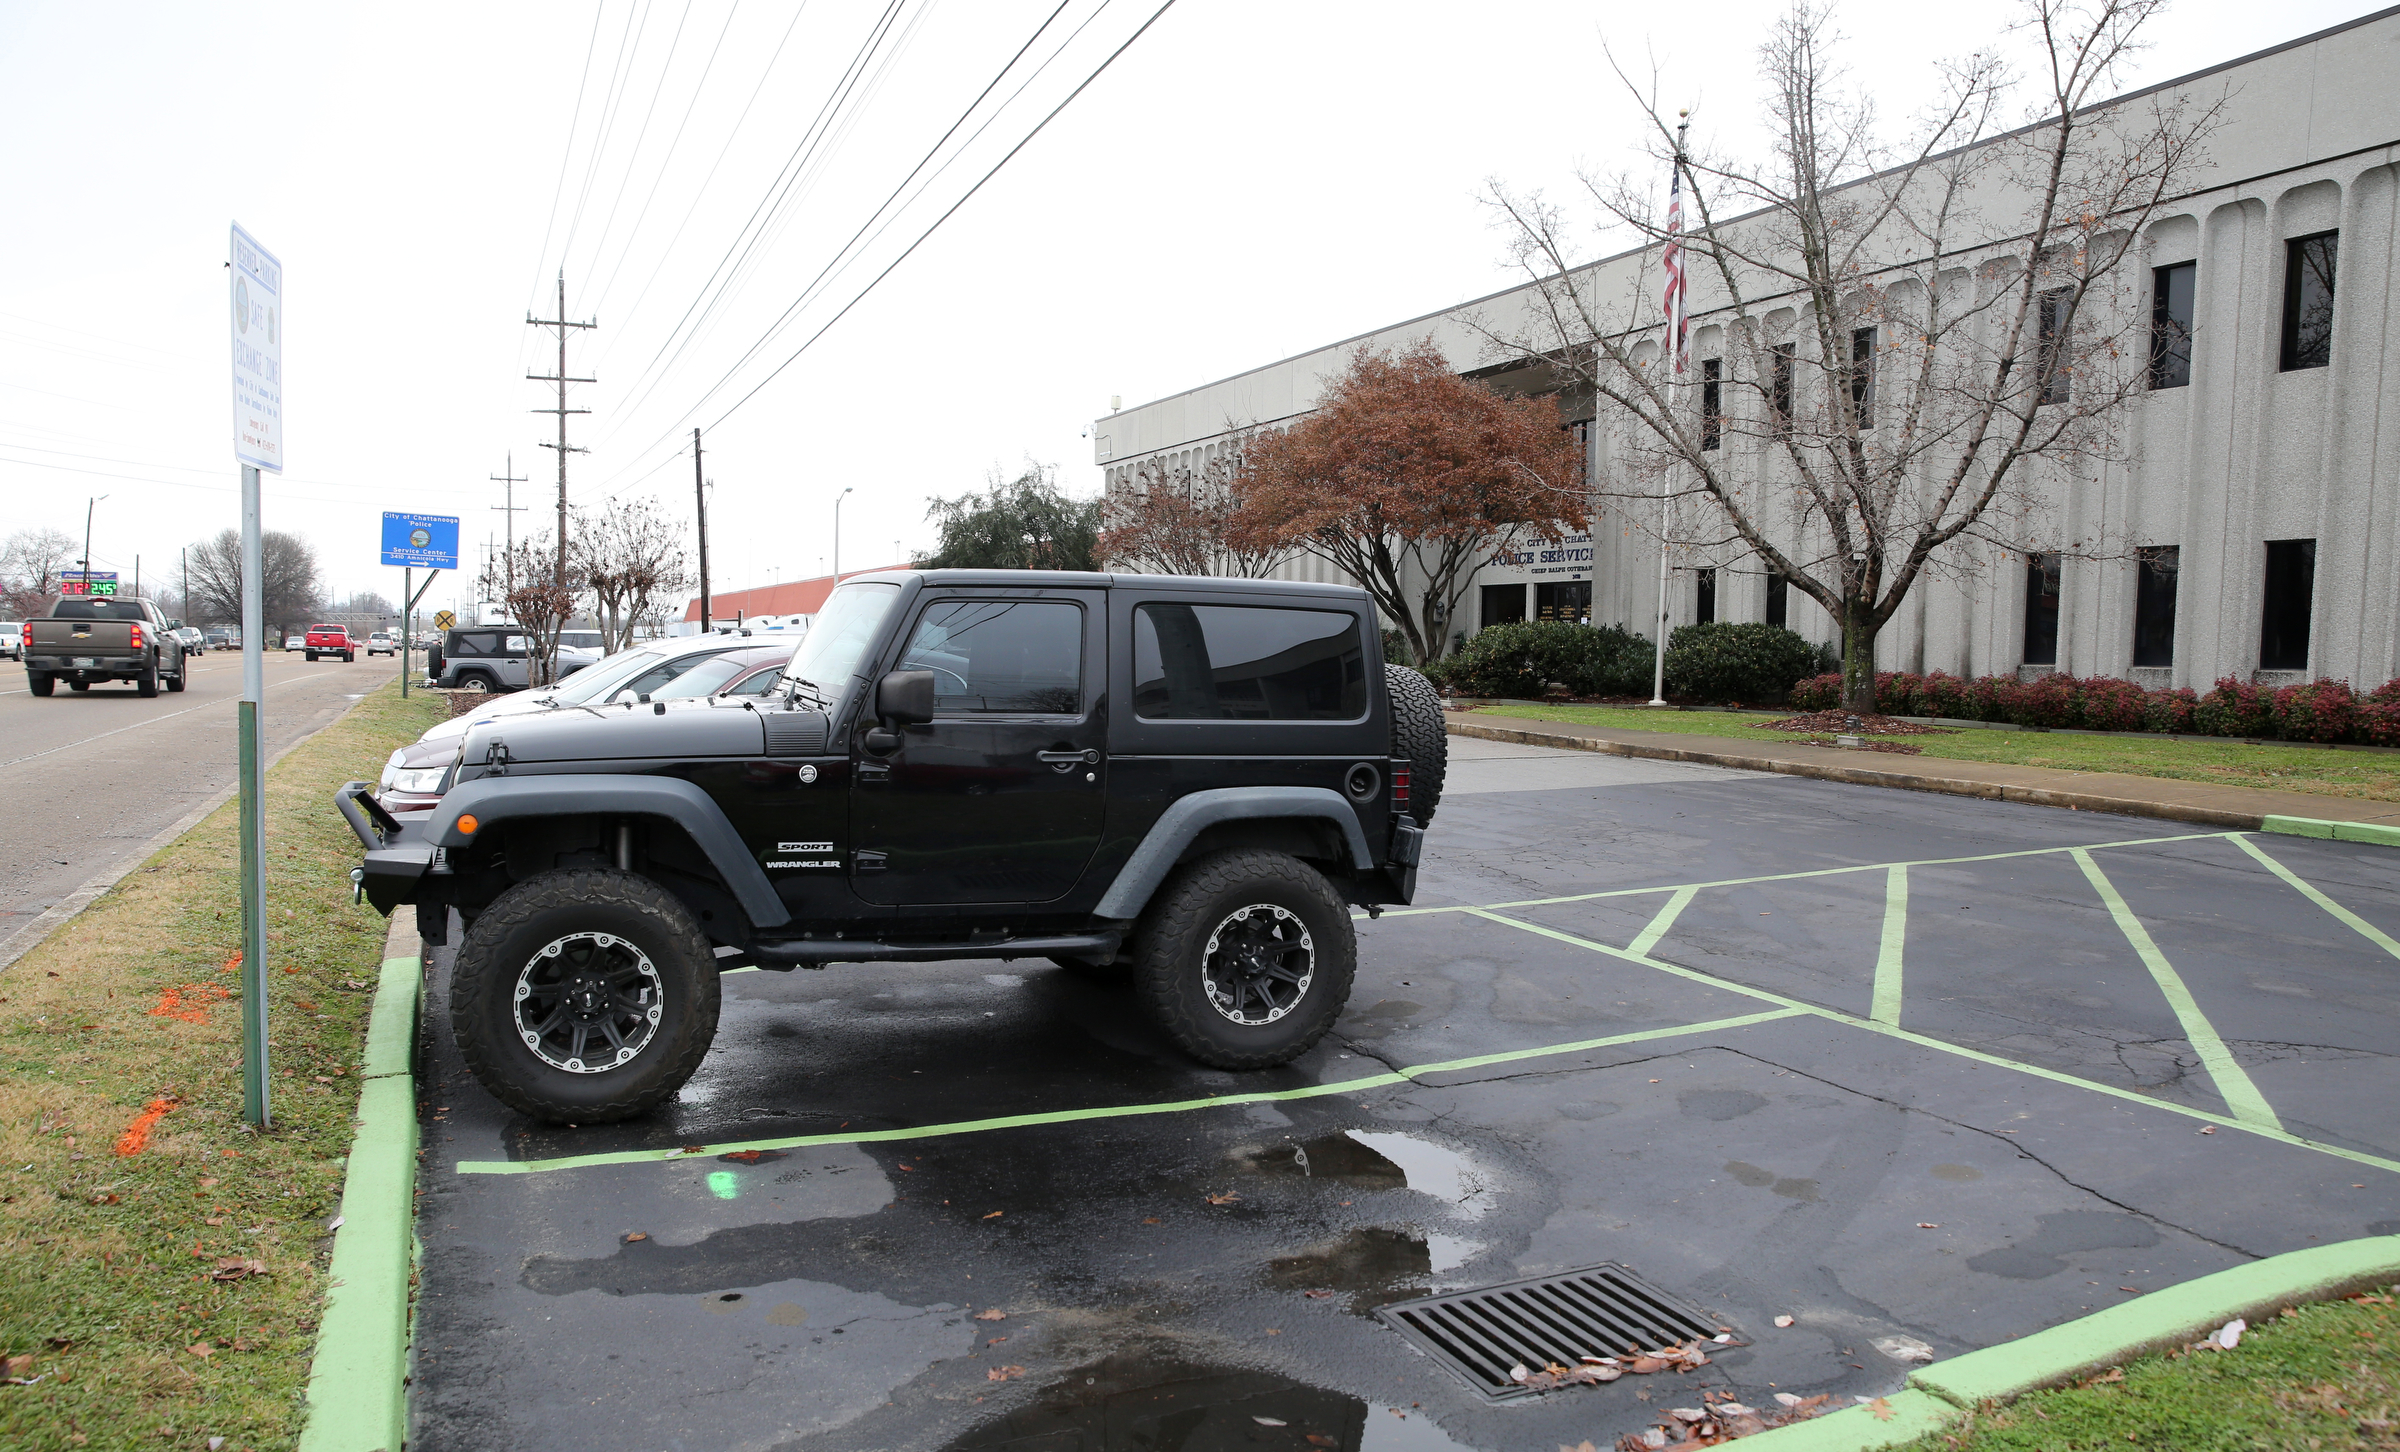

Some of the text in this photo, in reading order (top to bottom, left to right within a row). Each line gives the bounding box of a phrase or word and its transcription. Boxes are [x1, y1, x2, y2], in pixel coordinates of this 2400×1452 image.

[251, 299, 263, 331] SAFE
[236, 338, 278, 386] EXCHANGE ZONE
[384, 512, 400, 520] City
[413, 515, 458, 524] Chattanooga
[1527, 538, 1547, 547] CITY
[1491, 552, 1534, 566] POICE
[780, 843, 831, 851] SPORT
[766, 860, 842, 869] WRANGLER
